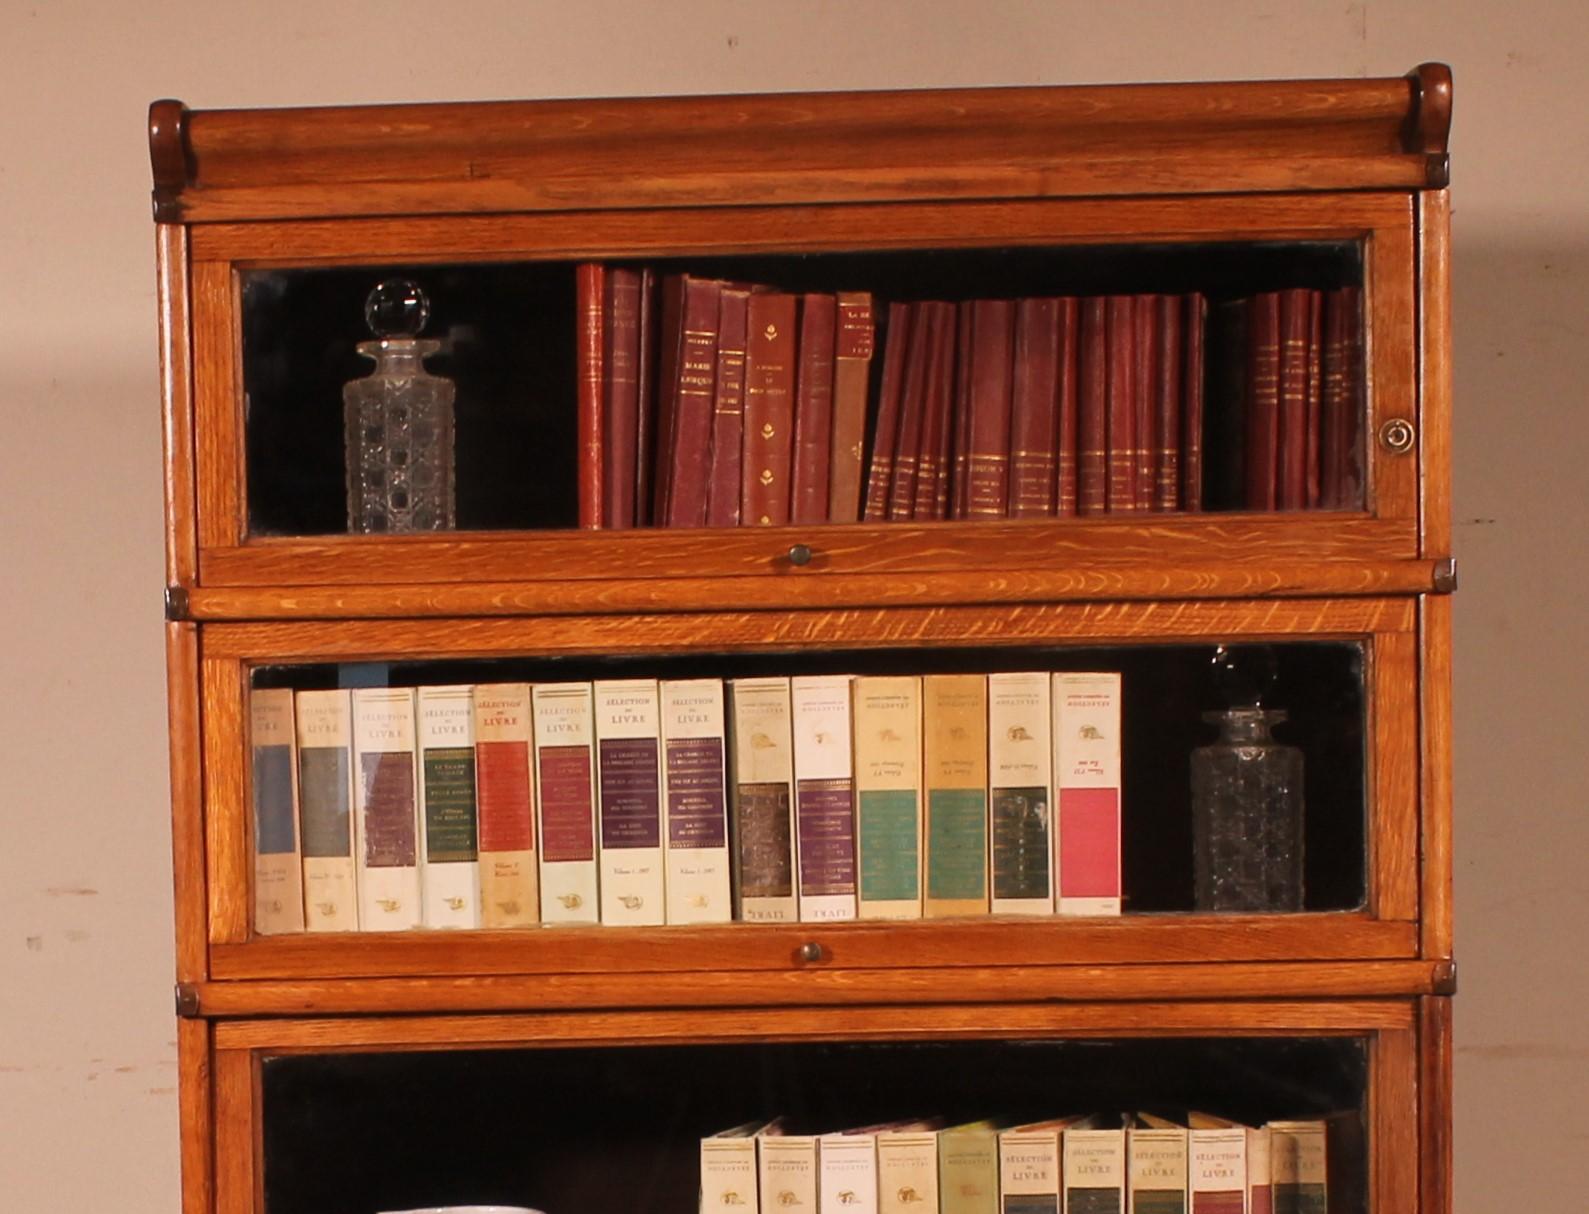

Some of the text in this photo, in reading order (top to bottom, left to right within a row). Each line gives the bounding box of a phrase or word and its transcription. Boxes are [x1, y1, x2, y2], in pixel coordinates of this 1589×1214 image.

[483, 716, 518, 727] LIVRE
[611, 715, 646, 725] LIVRE
[677, 714, 710, 724] LIVRE
[368, 728, 403, 739] LIVRE
[431, 725, 465, 736] LIVRE
[546, 723, 581, 734] LIVRE
[1078, 1165, 1110, 1175] LIVRE
[1142, 1168, 1175, 1177] LIVRE
[1202, 1169, 1235, 1178] LIVRE
[1012, 1171, 1047, 1181] LIVRE
